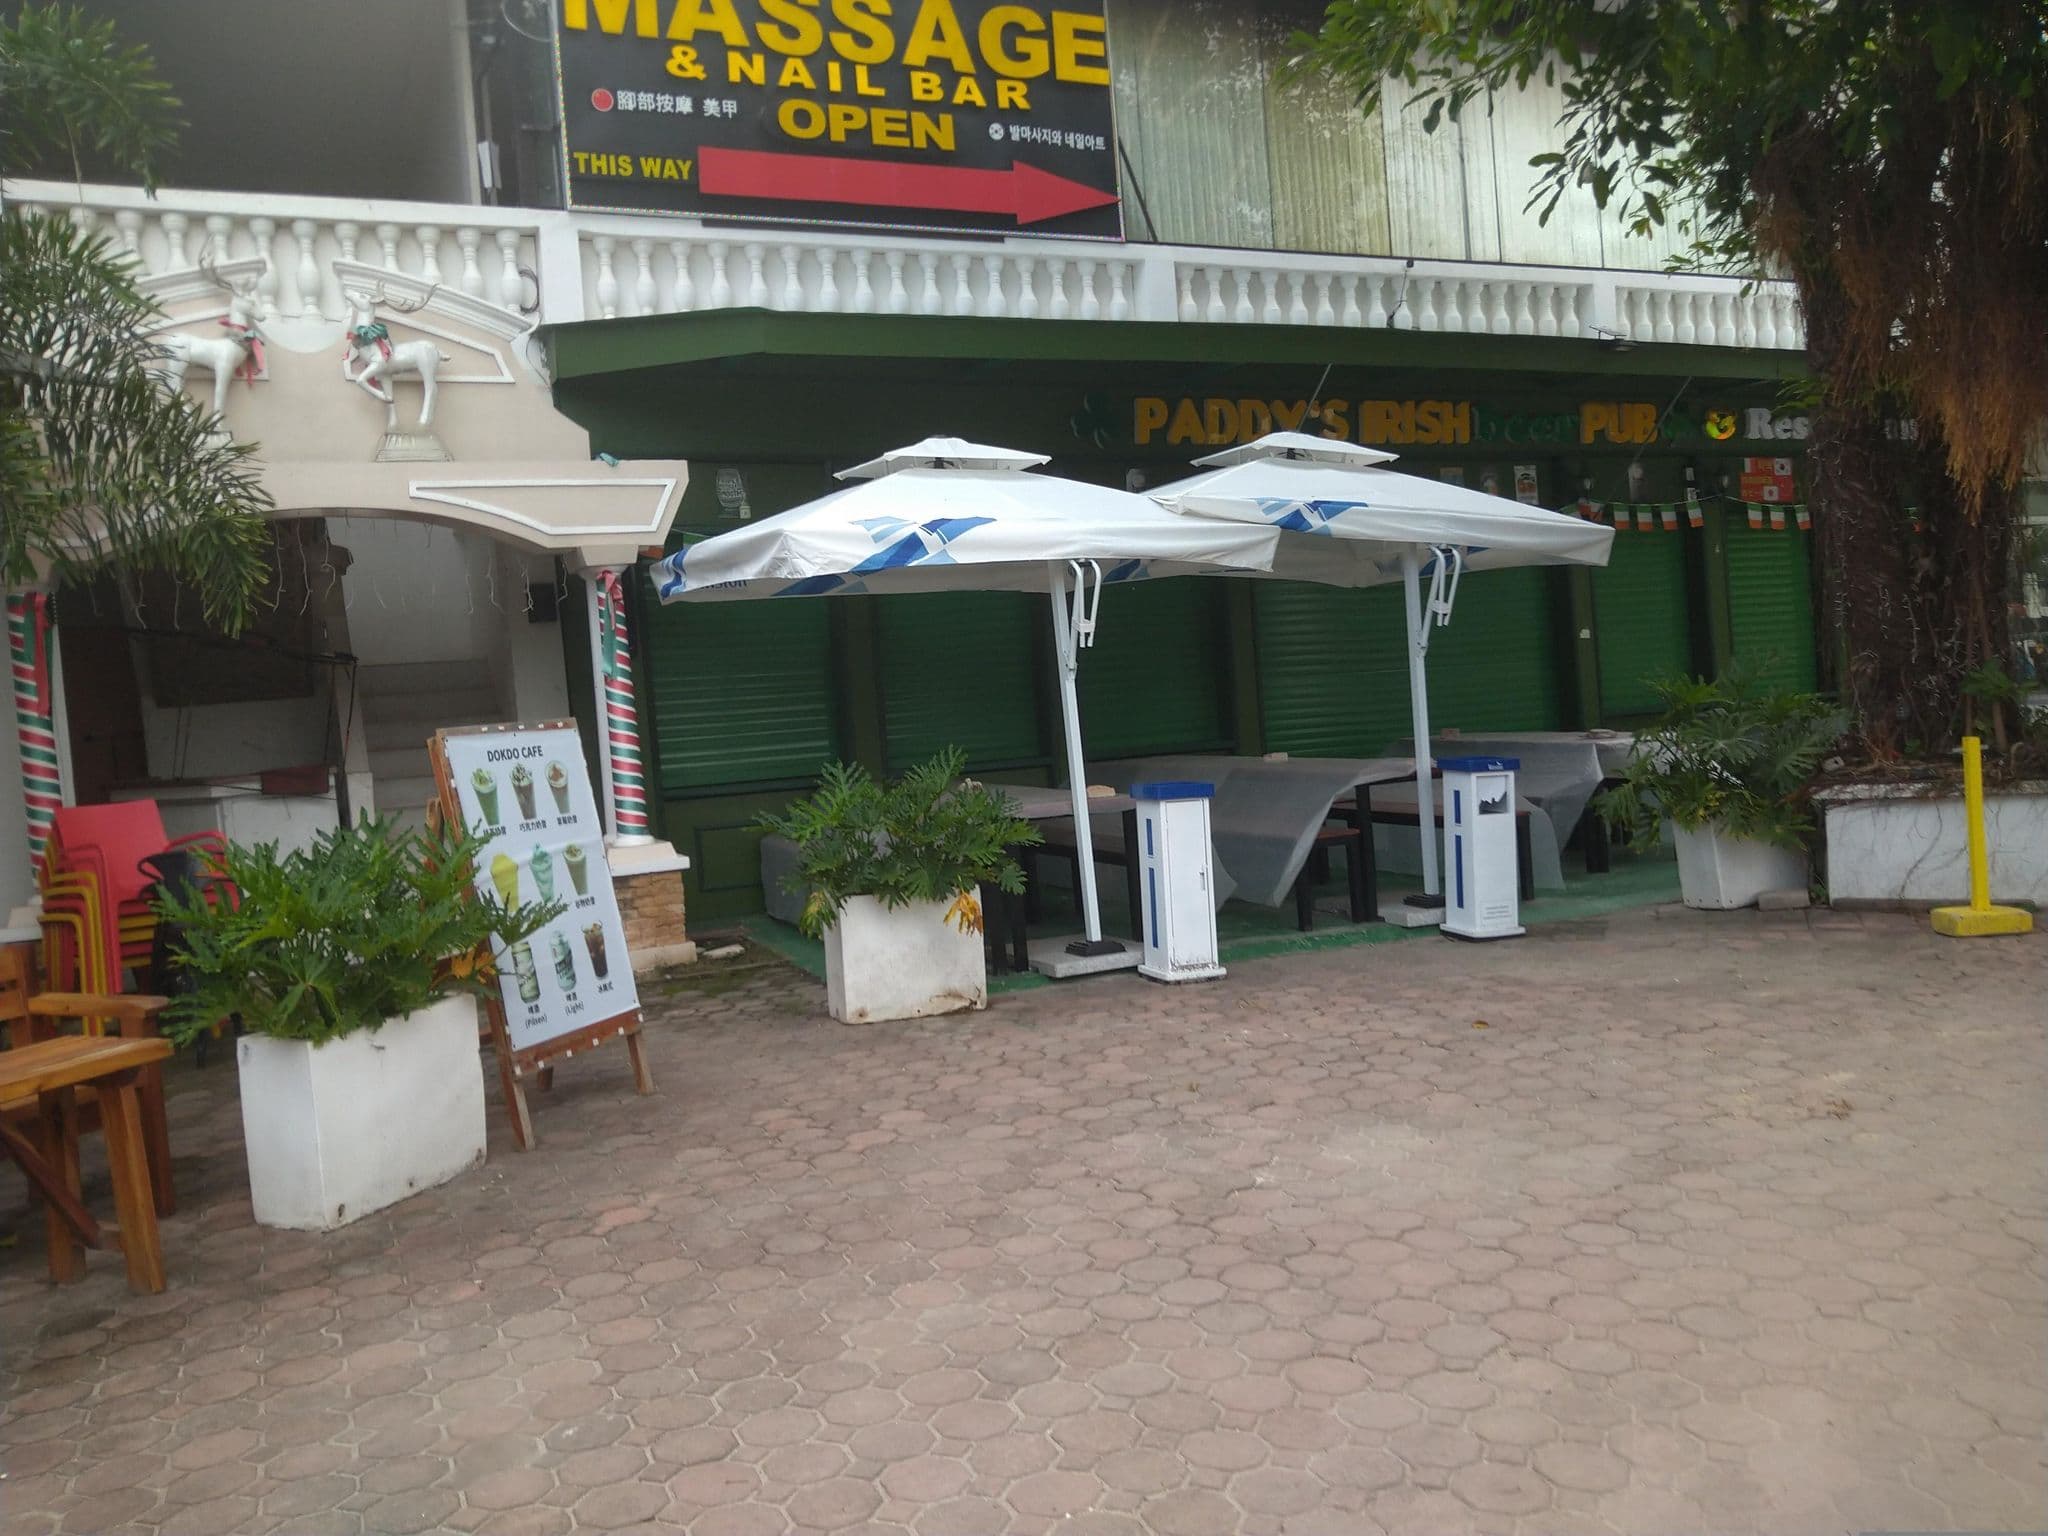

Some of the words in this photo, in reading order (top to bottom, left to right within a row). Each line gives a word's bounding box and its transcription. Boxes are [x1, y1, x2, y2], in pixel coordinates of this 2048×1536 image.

[564, 0, 1110, 85] MASSAGE
[665, 44, 707, 80] &
[728, 51, 886, 97] NAIL
[910, 70, 1031, 110] BAR
[703, 97, 738, 119] 美甲
[777, 98, 957, 152] OPEN
[1009, 124, 1062, 147] 발마사지와
[1064, 131, 1106, 151] 네일아트
[573, 151, 633, 178] THIS
[640, 155, 693, 181] WAY
[1133, 397, 1349, 446] PADDY'S
[1357, 398, 1471, 445] IRISH
[1579, 402, 1659, 446] PUB
[487, 747, 520, 762] DOKDO
[521, 745, 543, 759] CAFE
